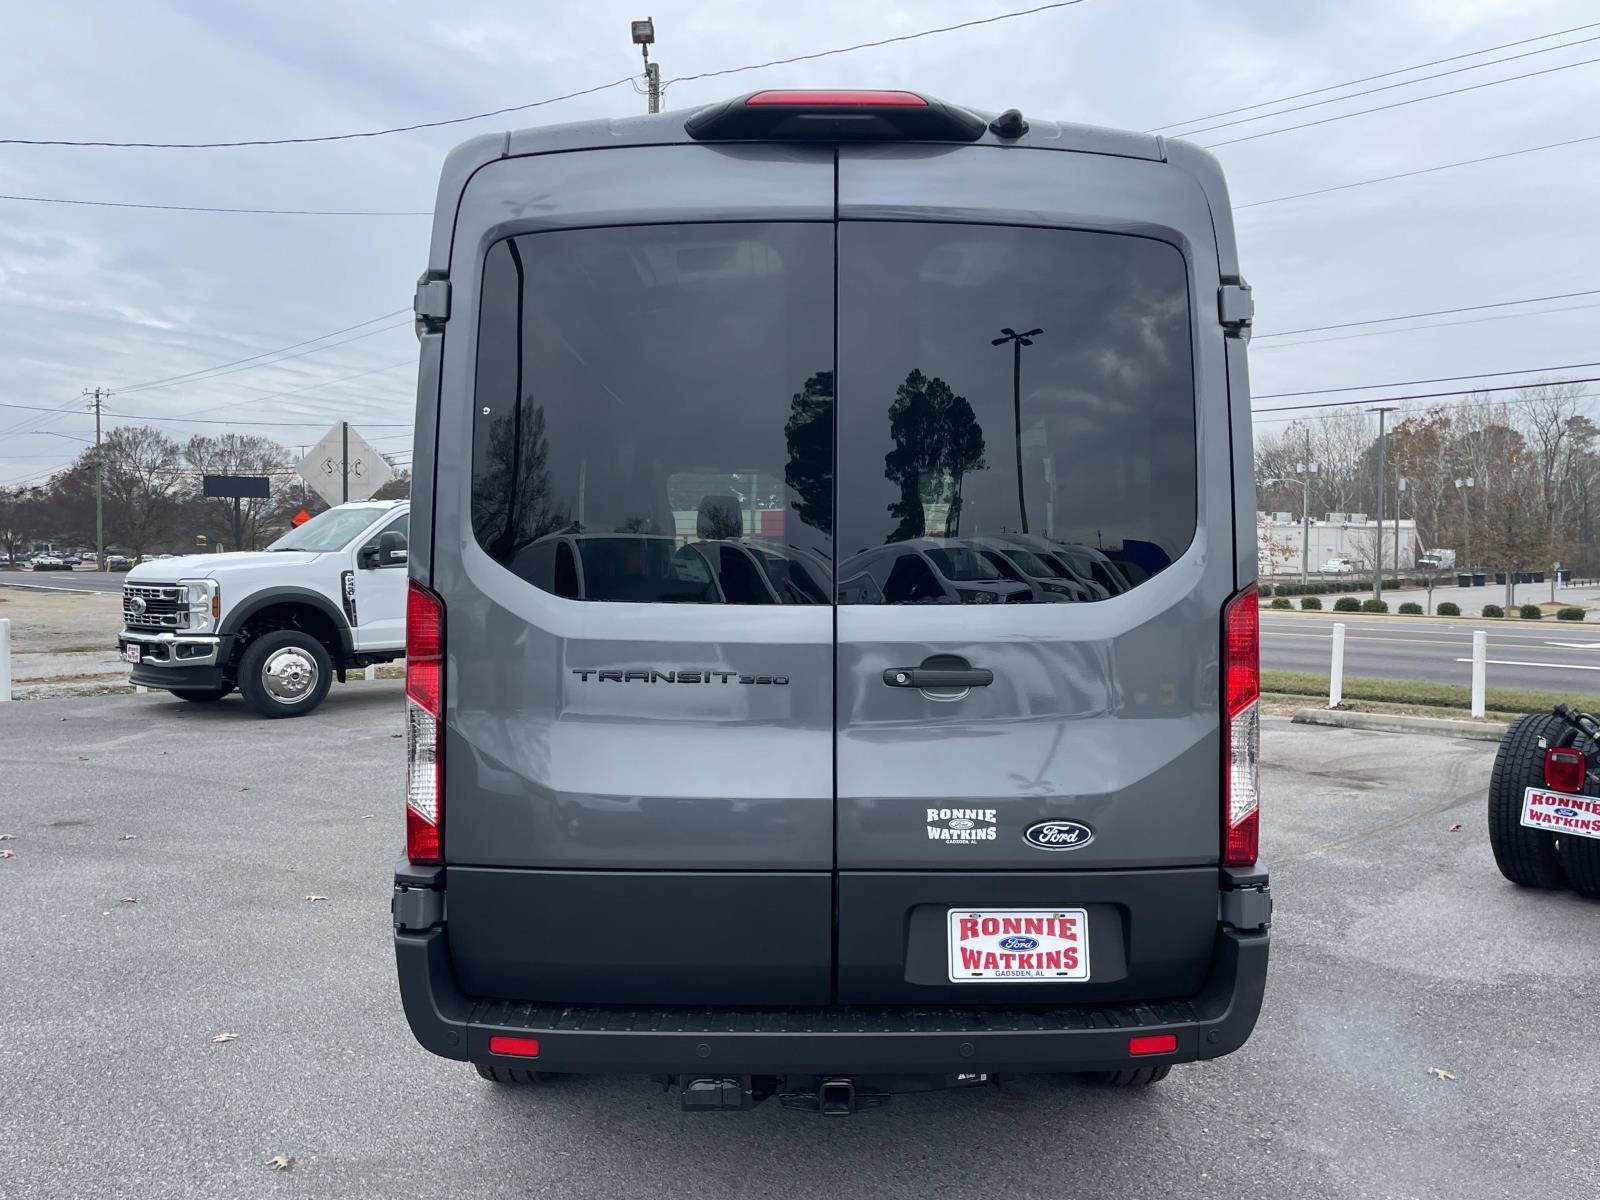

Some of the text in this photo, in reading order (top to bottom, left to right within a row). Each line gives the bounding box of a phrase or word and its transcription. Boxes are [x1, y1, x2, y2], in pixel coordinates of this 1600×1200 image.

[572, 669, 790, 685] TRANSIT 350
[1531, 794, 1600, 815] RONNIE
[926, 808, 997, 823] RONNIE
[1529, 809, 1600, 831] WATKINS
[926, 825, 997, 840] WATKINS
[1038, 825, 1080, 843] Ford
[959, 917, 1078, 942] RONNIE
[1004, 938, 1035, 950] Ford
[960, 946, 1079, 970] WATKINS
